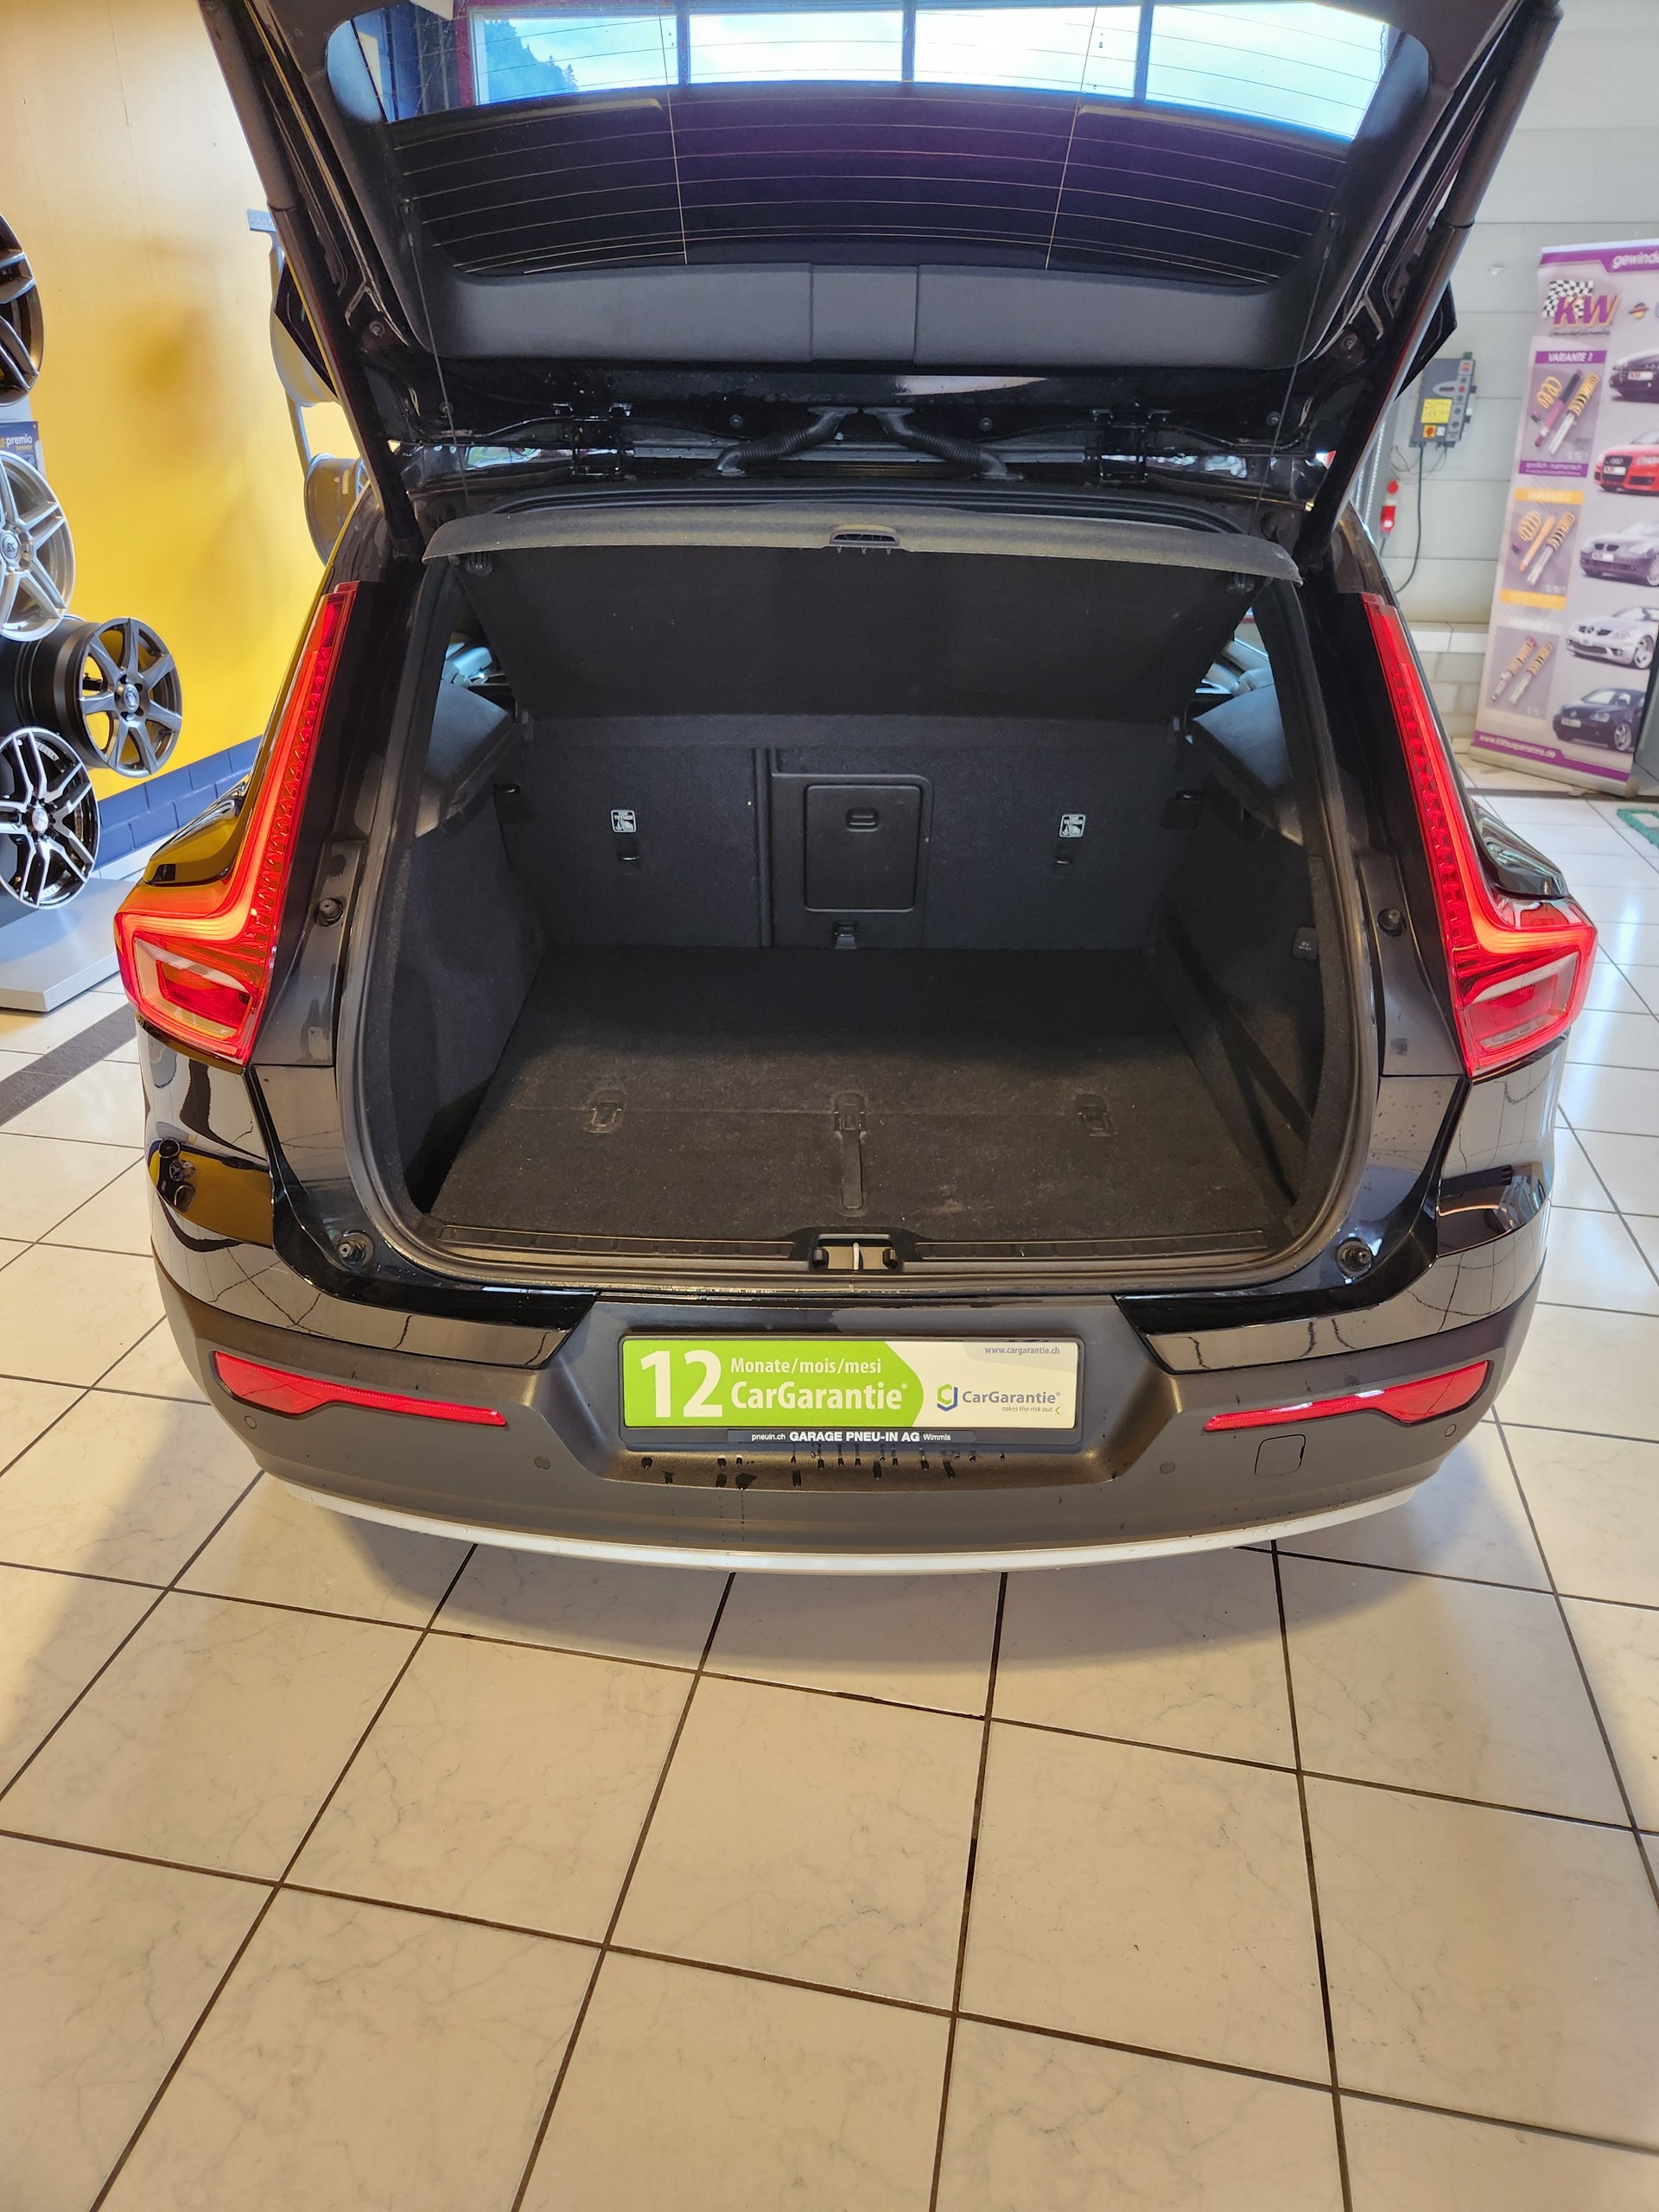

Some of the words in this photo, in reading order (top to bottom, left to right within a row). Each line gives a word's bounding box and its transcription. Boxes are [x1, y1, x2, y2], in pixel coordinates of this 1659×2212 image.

[1553, 294, 1621, 327] KW
[1548, 352, 1587, 363] VARIANTE
[6, 434, 33, 448] premio
[984, 1346, 1060, 1356] www.cargarantie.ch
[730, 1357, 881, 1375] Monate/mois/mesi
[639, 1349, 723, 1418] 12
[789, 1431, 842, 1442] GARAGE
[846, 1431, 899, 1442] PNEU-IN
[900, 1431, 920, 1442] AG
[923, 1433, 951, 1441] Wimmis
